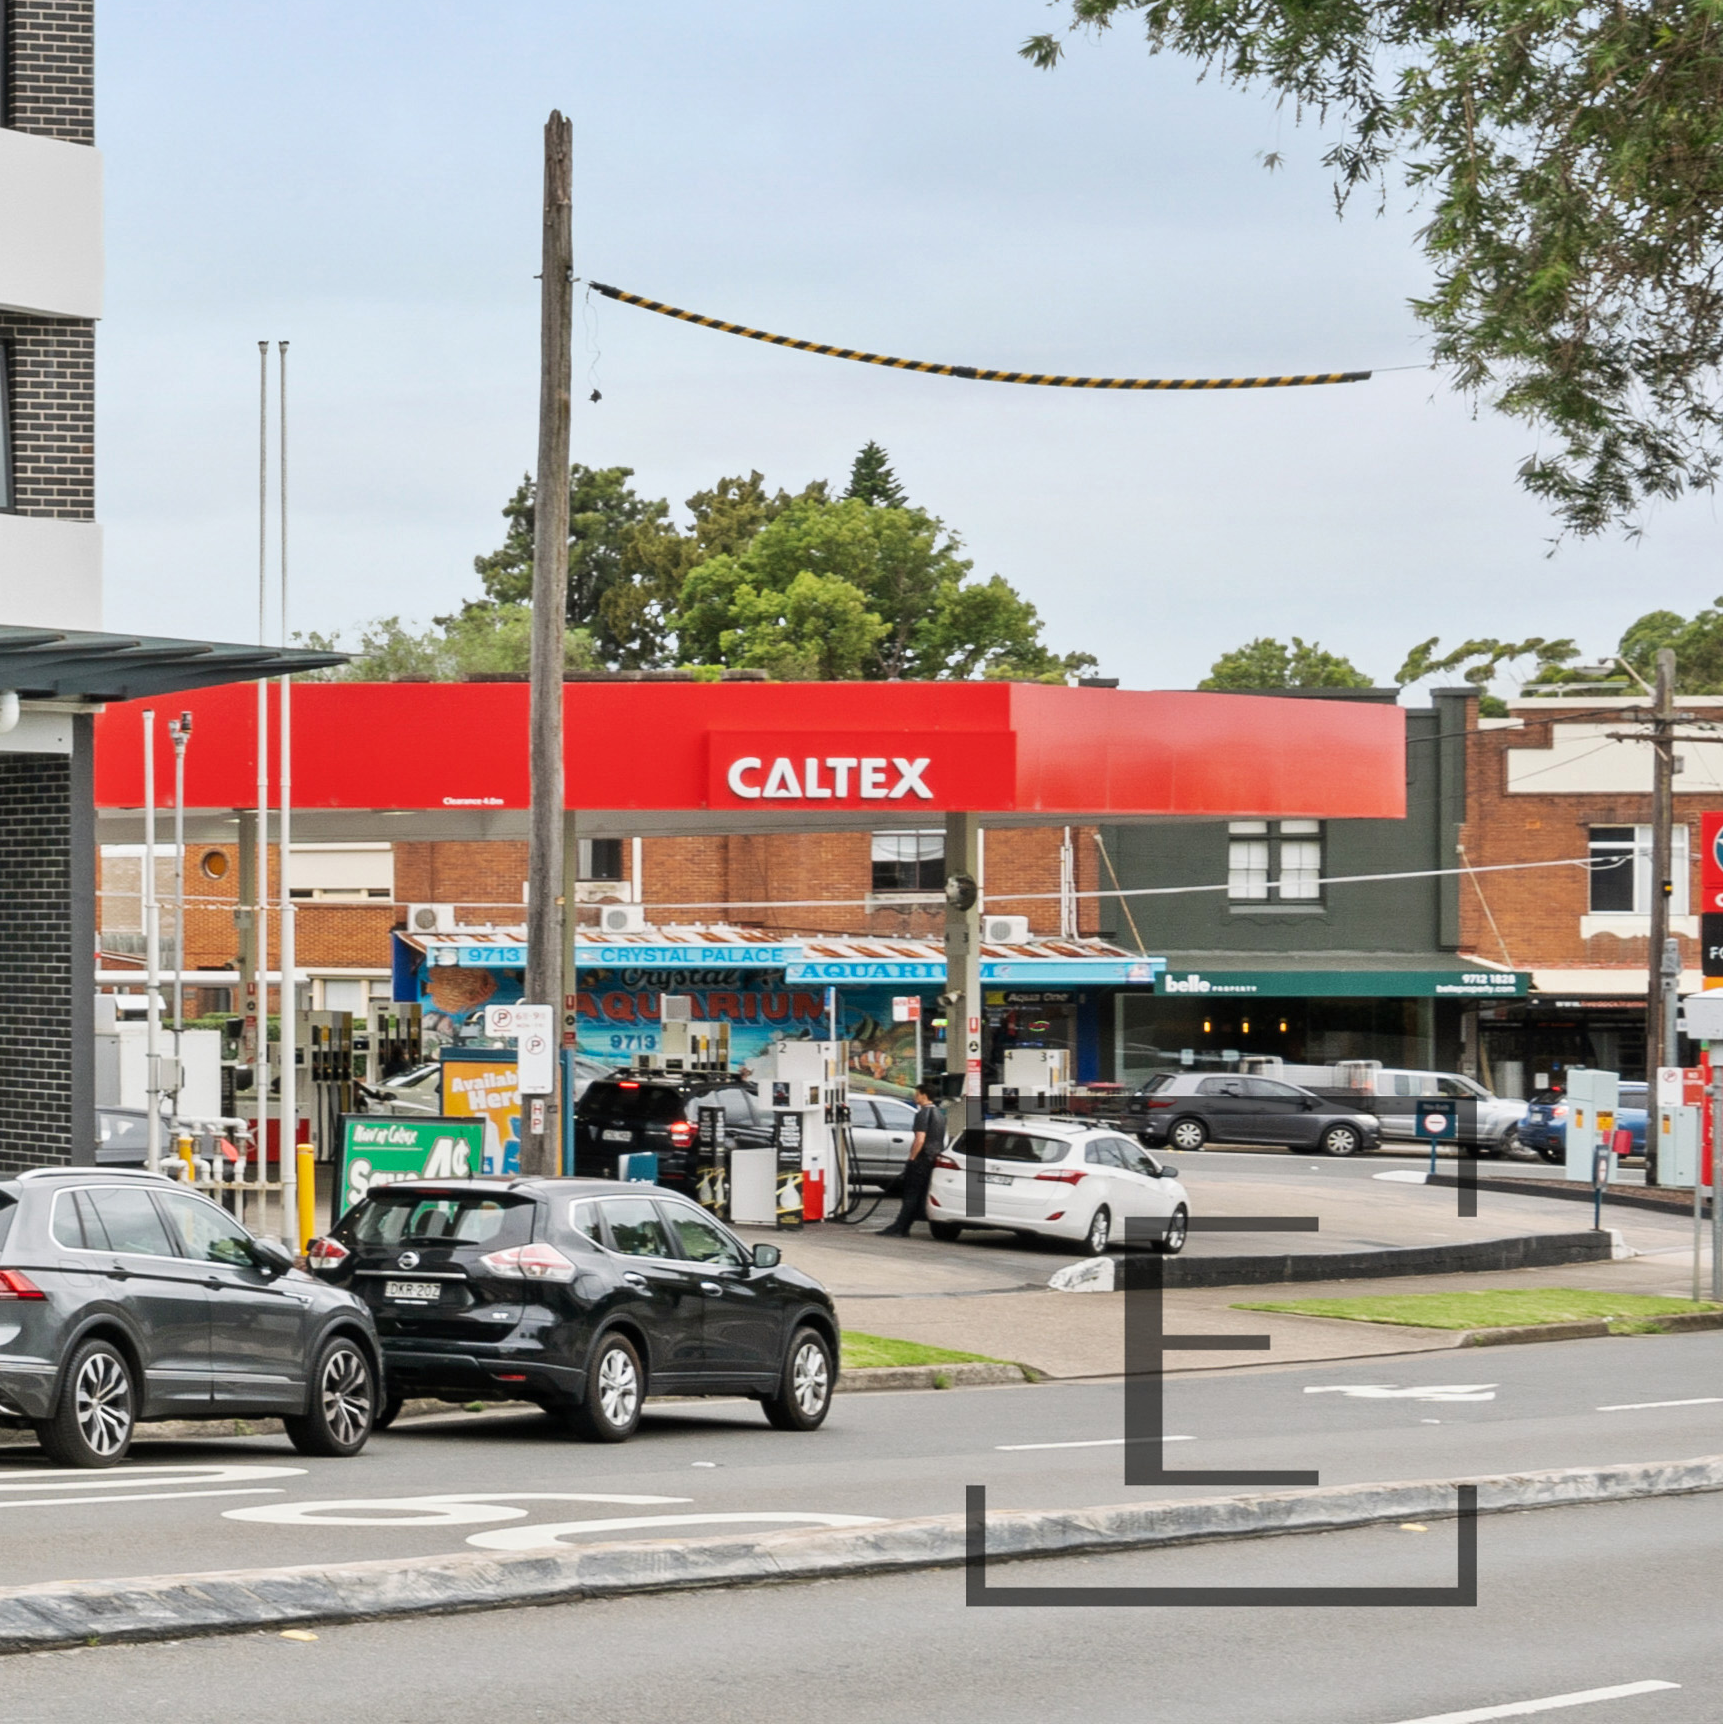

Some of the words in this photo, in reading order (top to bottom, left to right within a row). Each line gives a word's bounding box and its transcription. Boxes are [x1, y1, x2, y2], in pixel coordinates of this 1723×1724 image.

[727, 756, 934, 799] CALTEX
[443, 797, 482, 805] Clearance
[468, 947, 520, 962] 9713
[600, 947, 696, 963] CRYSTAL
[701, 947, 783, 963] PALACE
[621, 966, 740, 990] Crystal
[799, 963, 996, 978] AQUARIM
[1164, 974, 1211, 993] belle
[1461, 974, 1488, 984] 9712
[1490, 974, 1516, 984] 1828
[1435, 984, 1516, 994] belleproperty.com
[1008, 993, 1040, 1002] Aqua
[1043, 993, 1069, 1002] One
[610, 1034, 656, 1050] 9713
[778, 1043, 787, 1054] 2
[1040, 1052, 1047, 1062] 3
[451, 1071, 519, 1093] Availab
